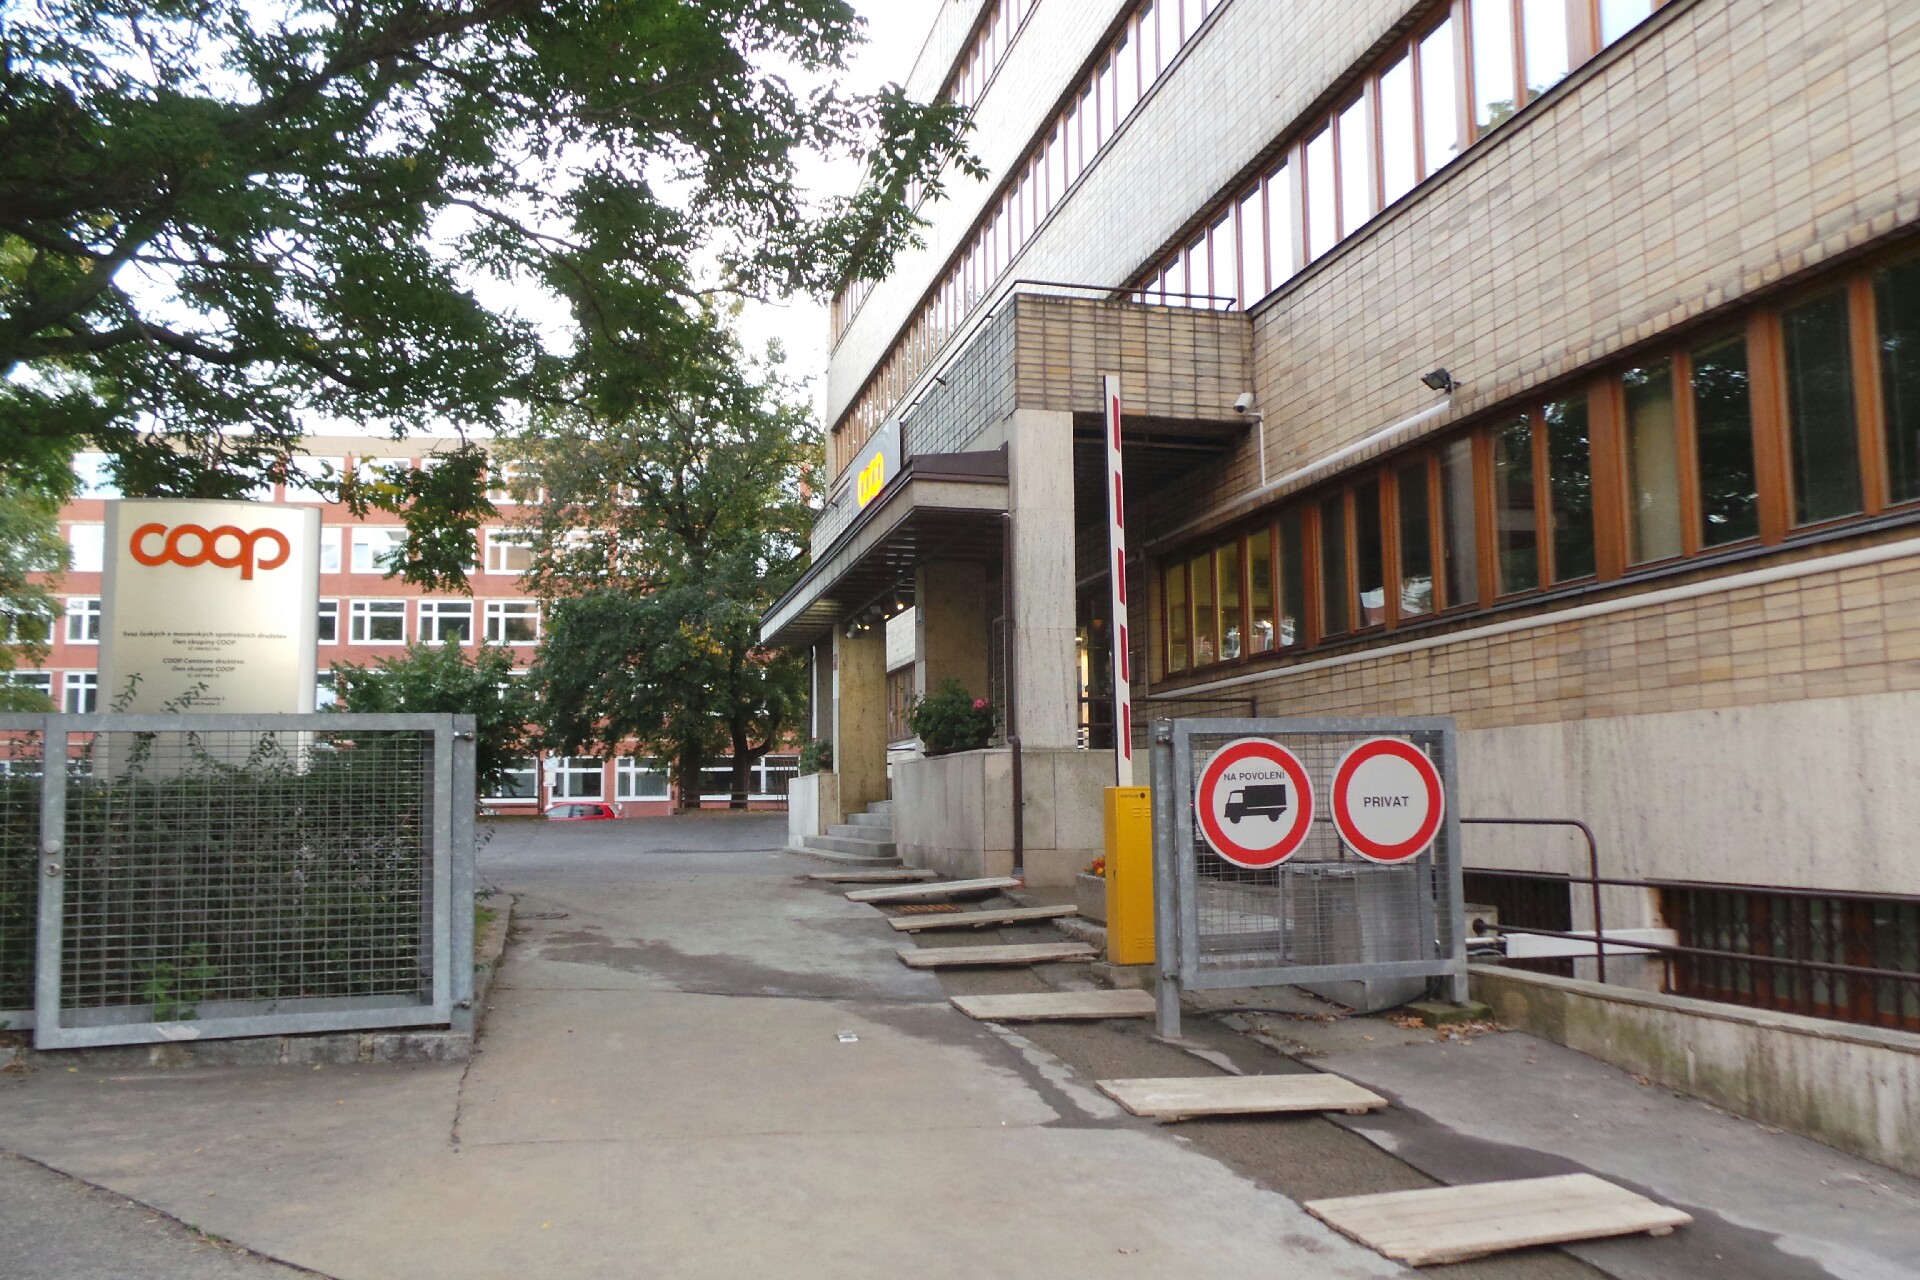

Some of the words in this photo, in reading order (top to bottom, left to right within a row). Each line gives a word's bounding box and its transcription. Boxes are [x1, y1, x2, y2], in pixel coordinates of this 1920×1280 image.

[129, 522, 291, 581] coop
[1223, 773, 1237, 781] NA
[1363, 796, 1410, 808] PRIVAT
